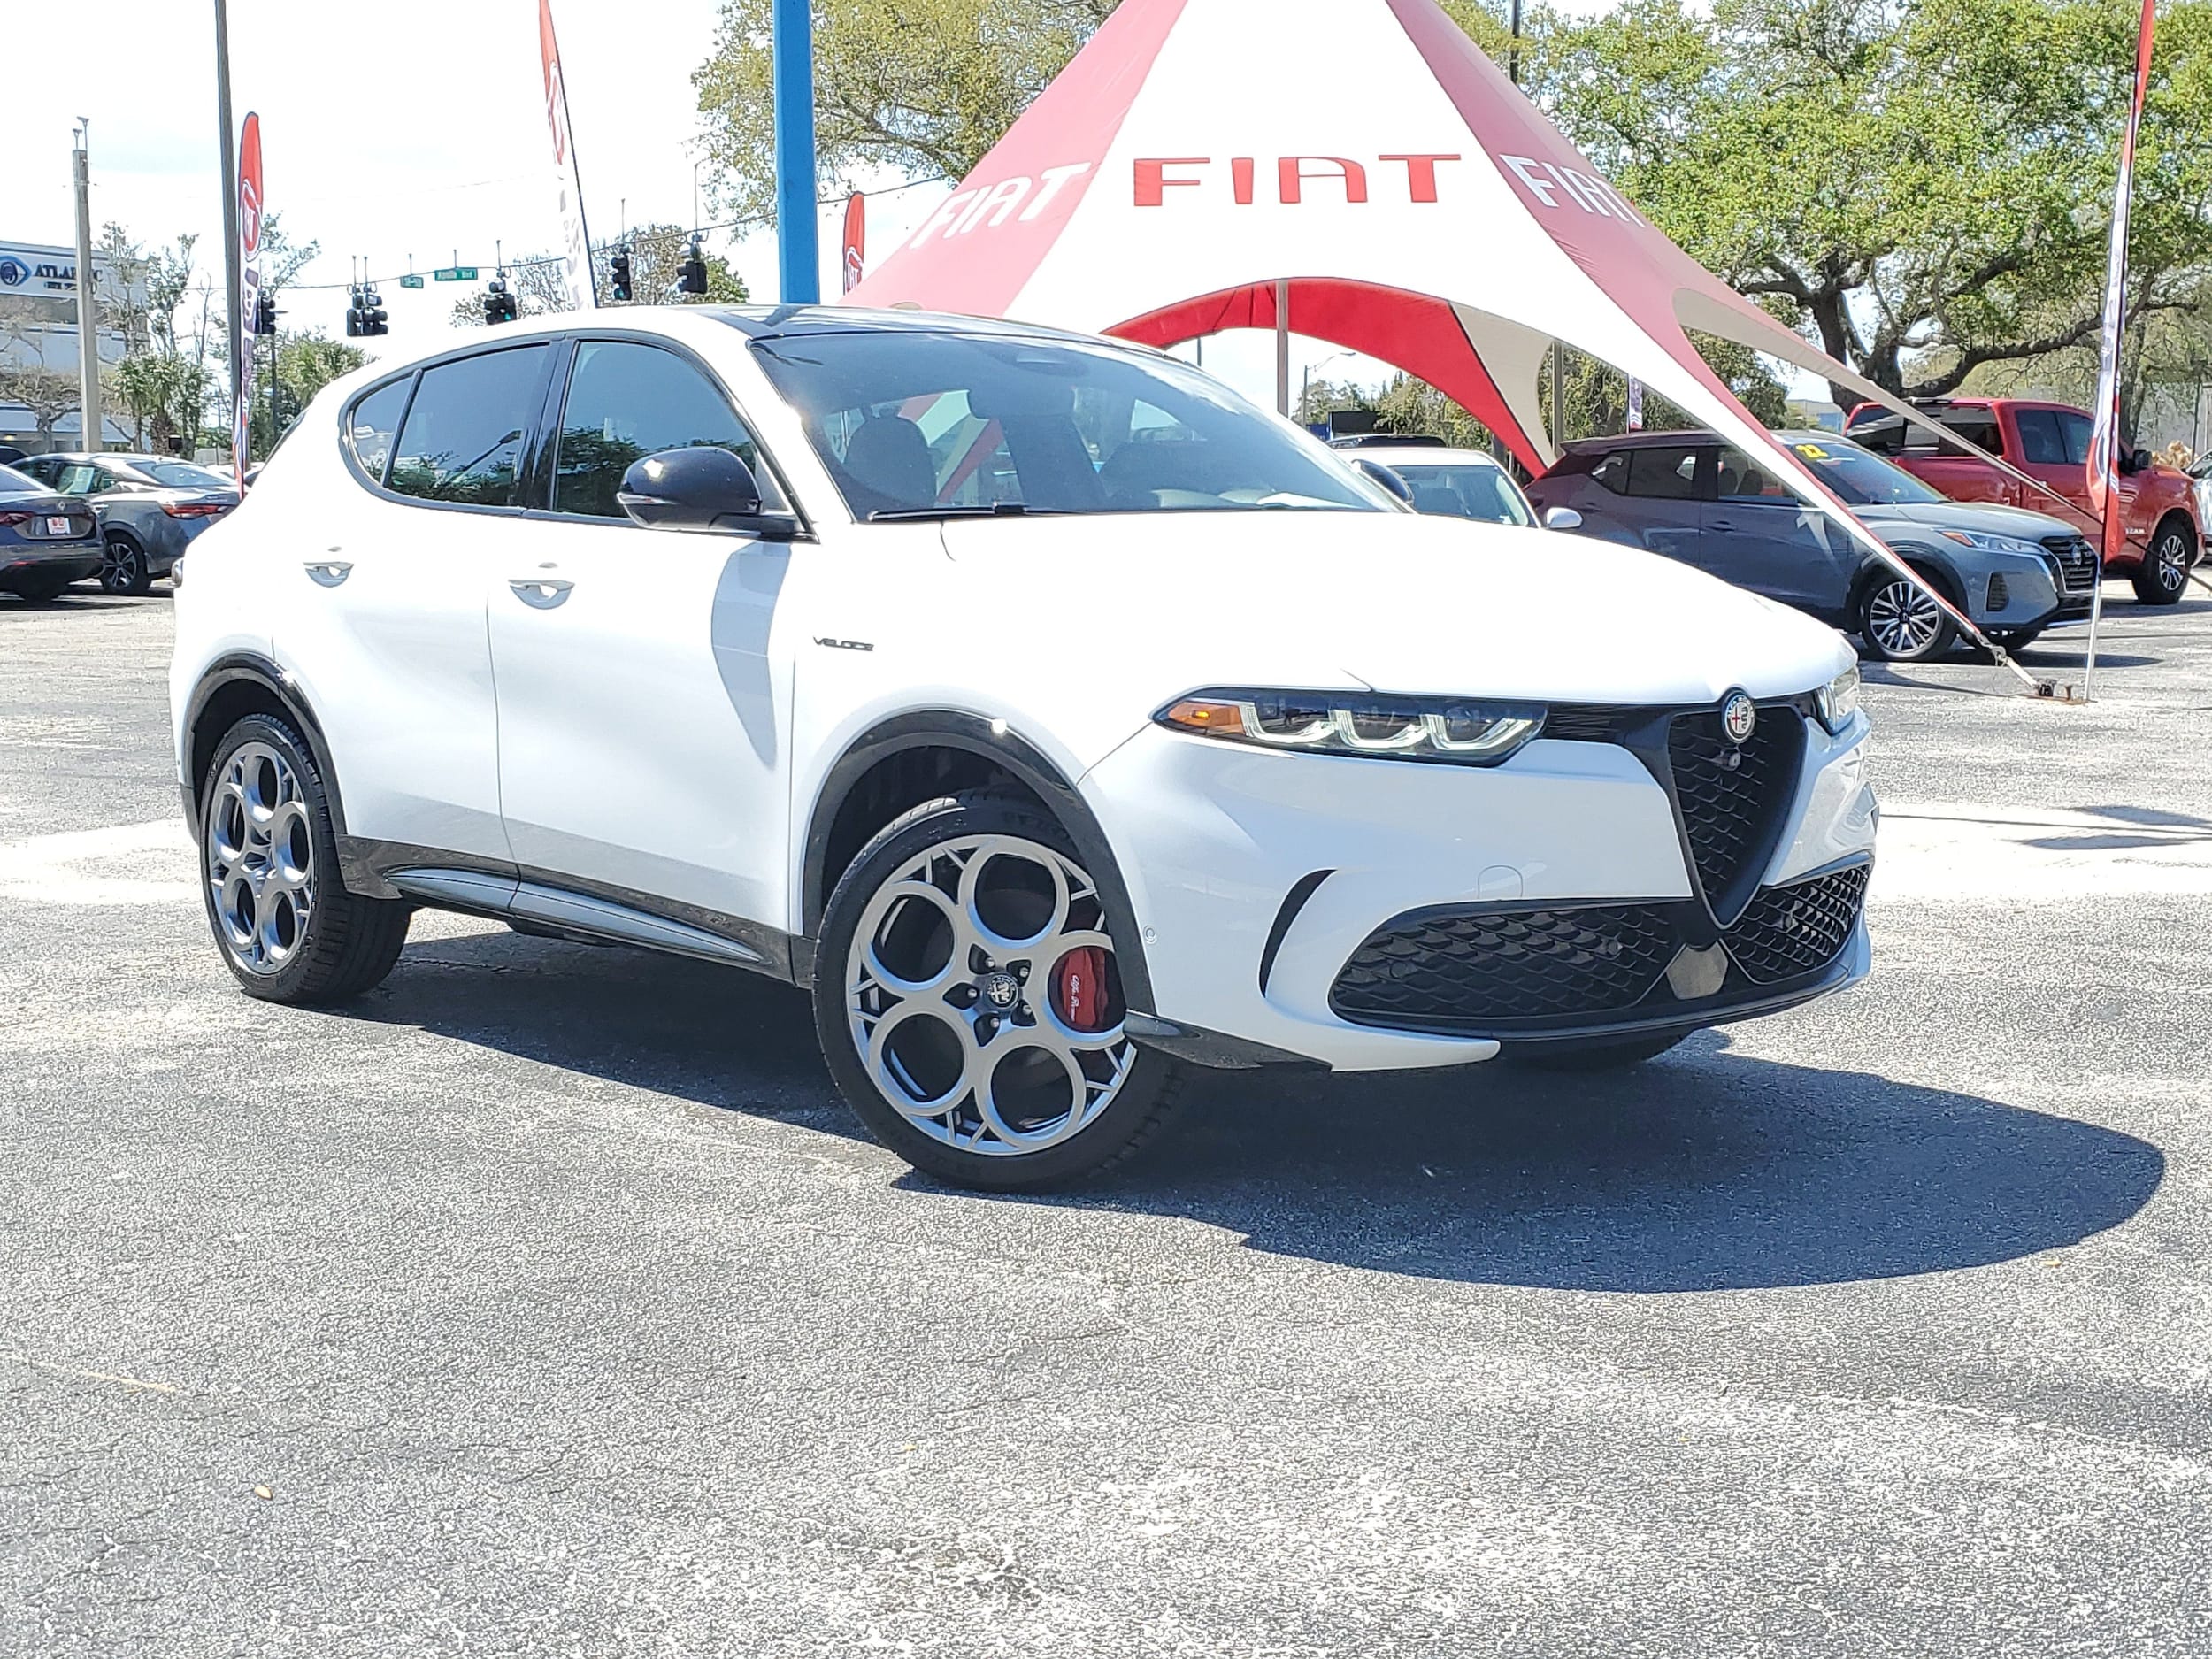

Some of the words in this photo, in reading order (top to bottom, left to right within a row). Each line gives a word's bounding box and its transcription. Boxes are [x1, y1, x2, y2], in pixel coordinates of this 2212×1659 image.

[908, 160, 1093, 250] FIAT
[1133, 154, 1461, 206] FIAT
[1498, 153, 1647, 228] FIAT
[1795, 443, 1829, 458] 22
